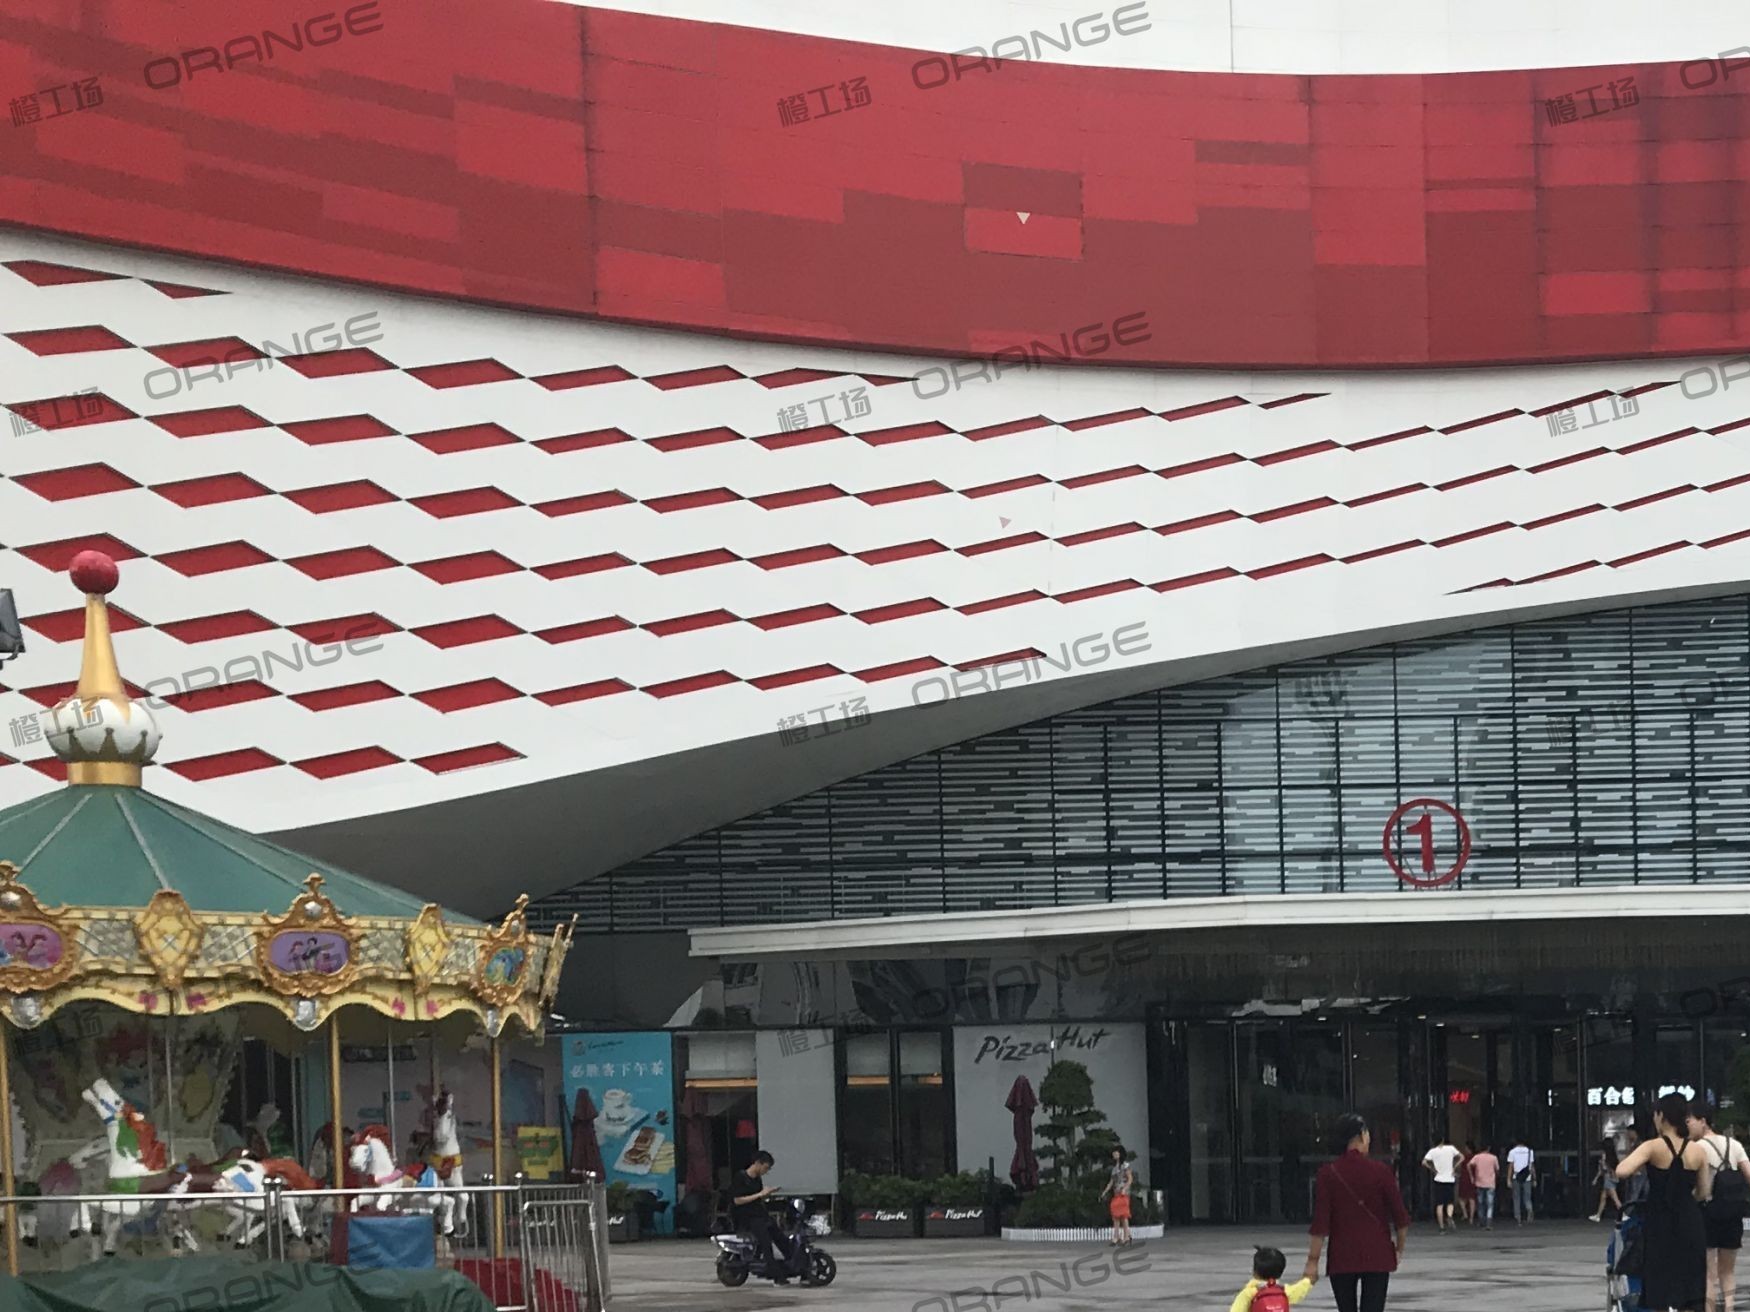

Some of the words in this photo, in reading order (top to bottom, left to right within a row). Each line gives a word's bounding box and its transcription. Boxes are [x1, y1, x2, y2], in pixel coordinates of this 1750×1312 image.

[974, 1035, 1049, 1064] Pizza
[1056, 1025, 1112, 1050] Hut
[571, 1060, 664, 1078] 必胜客下午茶
[875, 1210, 896, 1221] Pizza
[945, 1209, 966, 1219] Pizza
